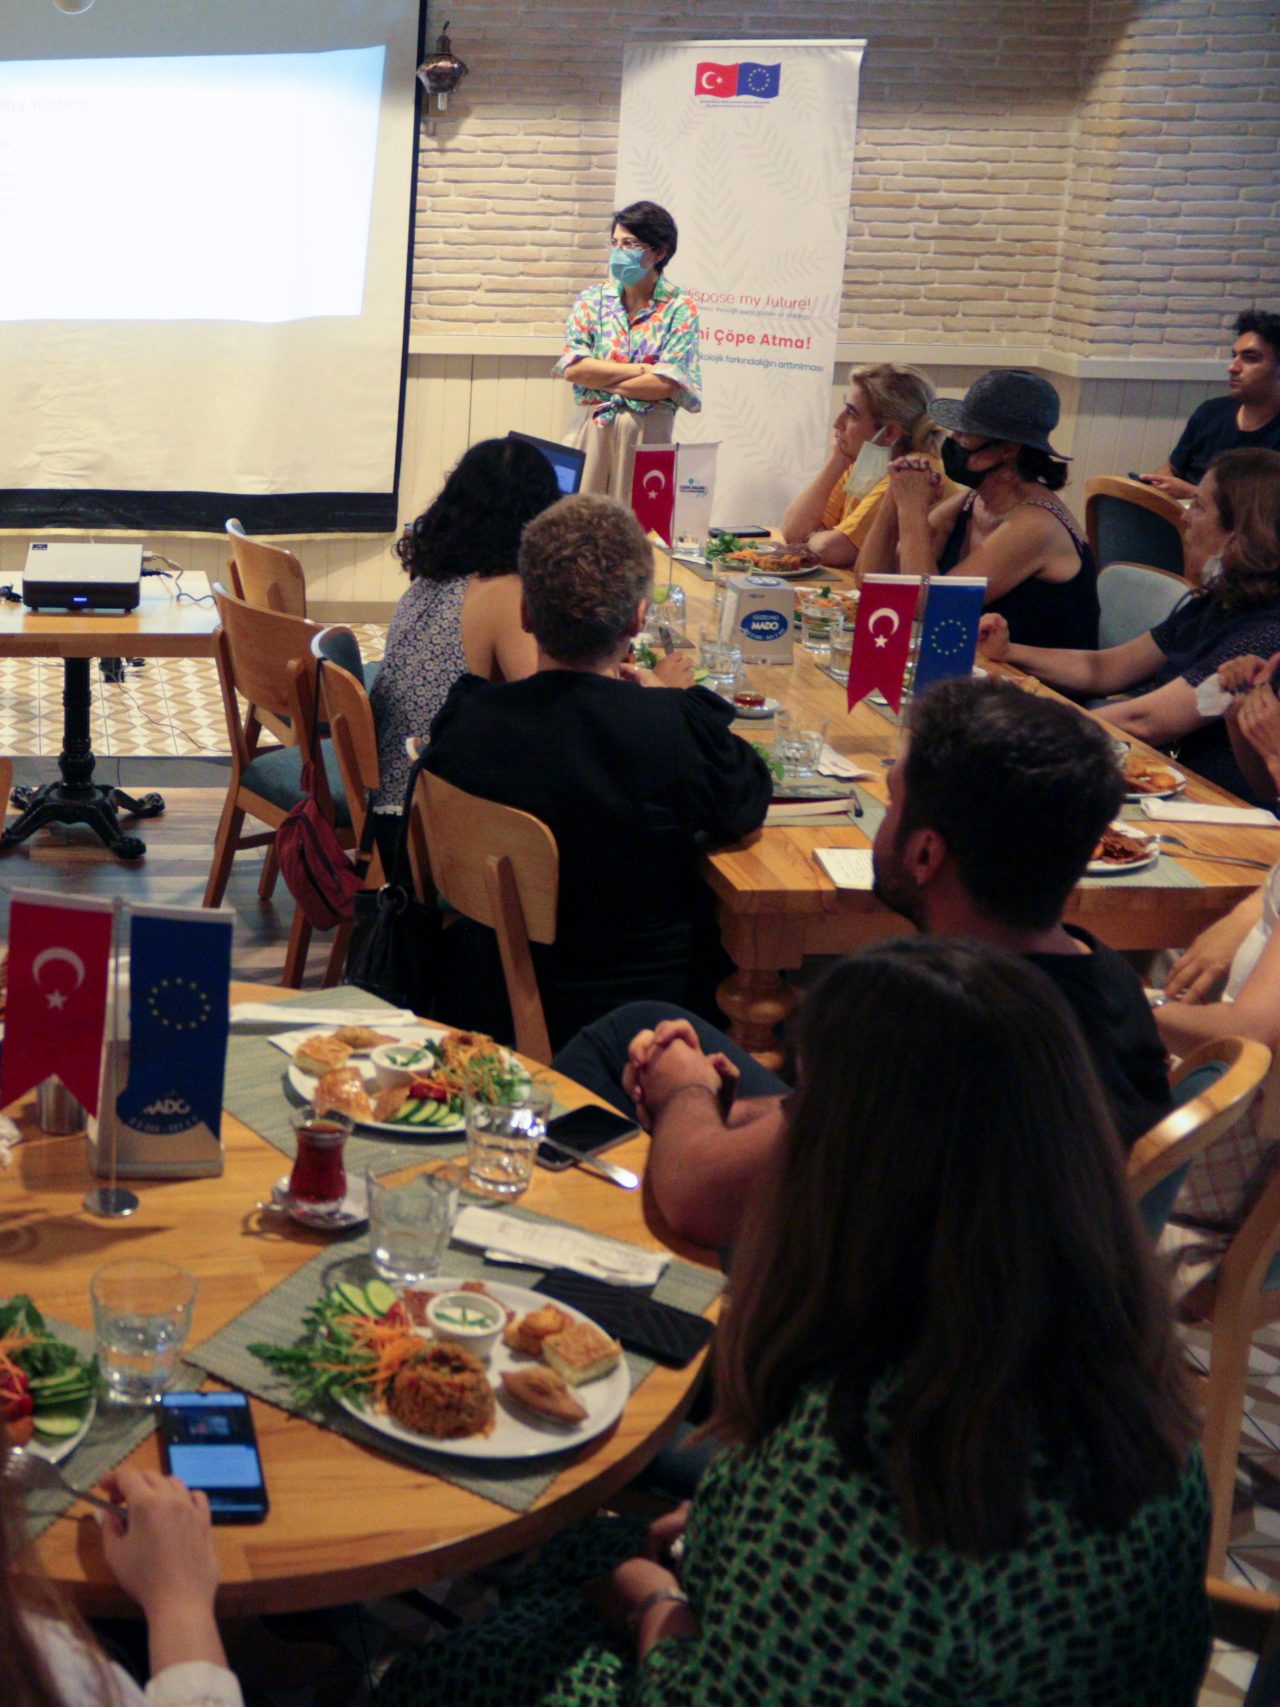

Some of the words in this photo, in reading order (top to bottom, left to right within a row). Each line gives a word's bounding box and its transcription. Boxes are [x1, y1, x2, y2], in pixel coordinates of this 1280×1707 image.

[739, 294, 761, 307] my
[766, 294, 812, 311] future!
[714, 328, 755, 347] Çöpe
[760, 333, 812, 350] Atma!
[751, 621, 779, 630] MADO
